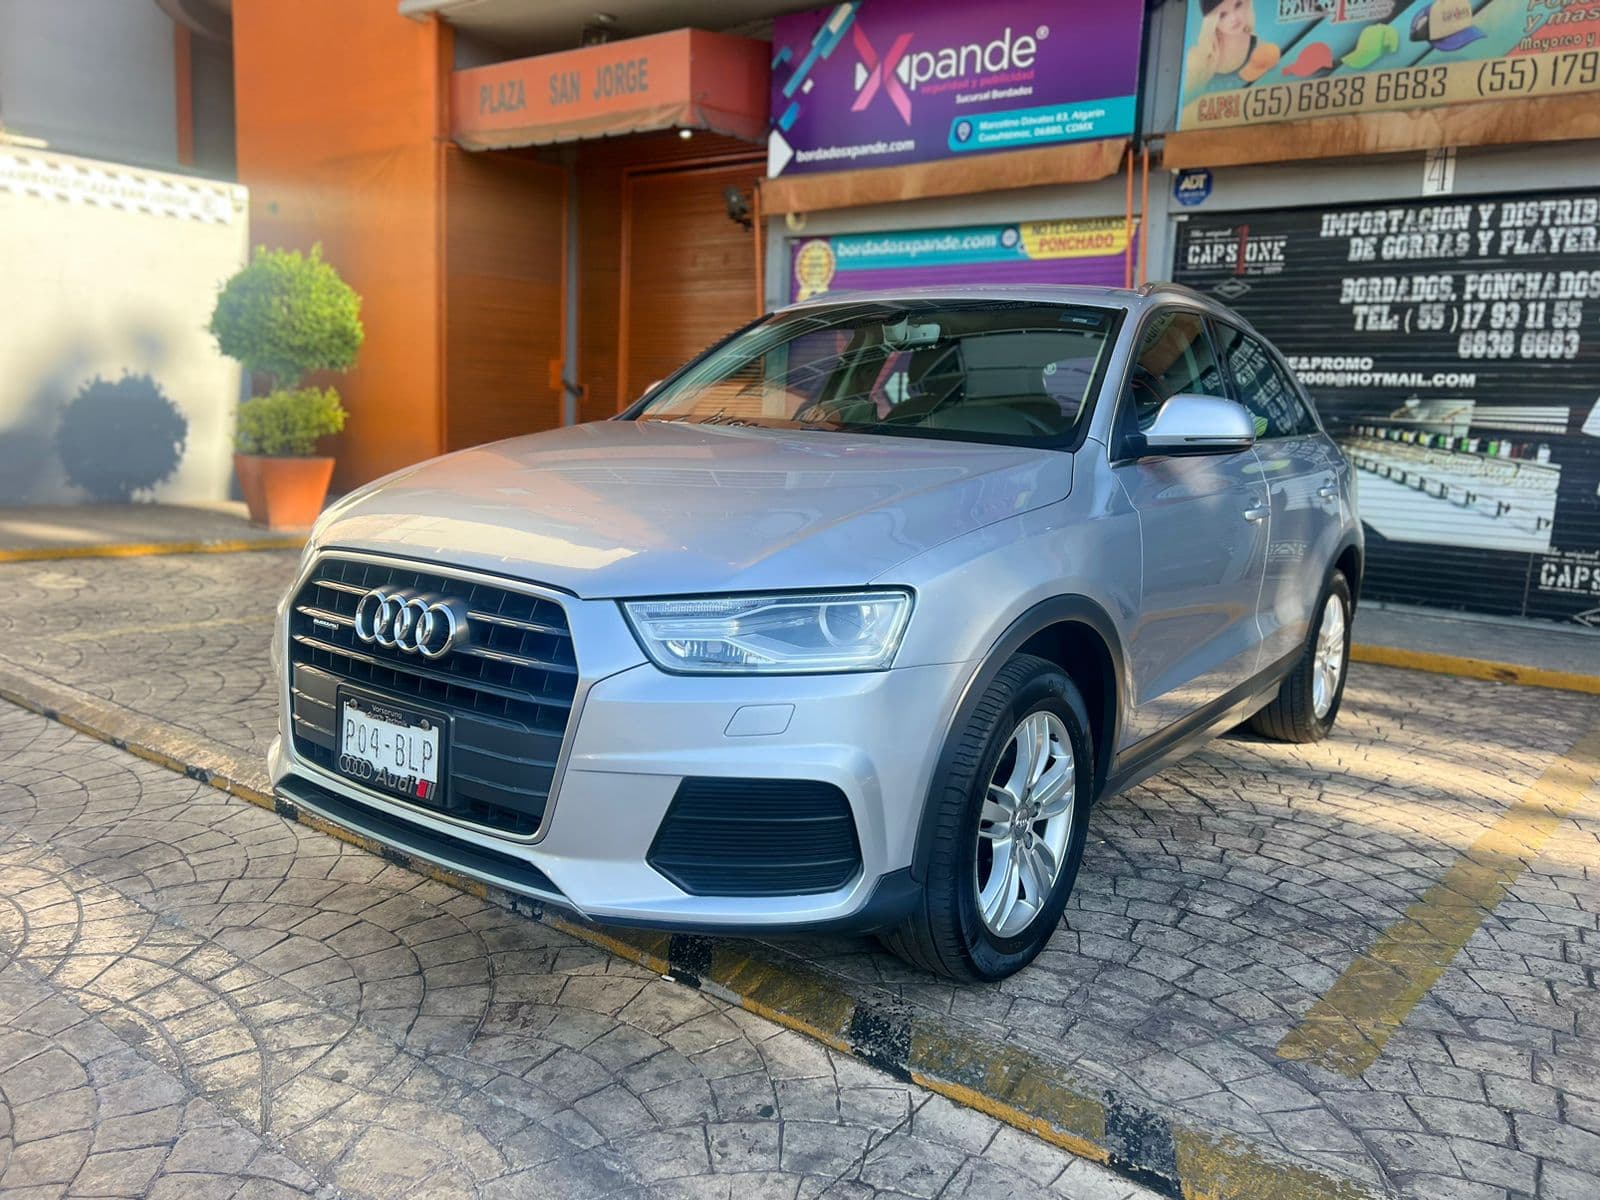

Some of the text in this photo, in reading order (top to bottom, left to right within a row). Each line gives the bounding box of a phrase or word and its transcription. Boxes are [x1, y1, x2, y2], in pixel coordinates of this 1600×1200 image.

[480, 58, 648, 116] PLAZA SAN JORGE
[991, 86, 1033, 100] Bordados
[1297, 74, 1365, 113] 6838
[1375, 67, 1447, 105] 6683
[1477, 57, 1538, 97] (55)
[796, 141, 915, 163] bordadosxpande.com
[1180, 174, 1208, 191] ADT
[1319, 198, 1600, 237] IMPORTACION Y DISTRIB
[837, 234, 997, 258] bordadosxpande.com
[1039, 233, 1114, 252] PONCHADO
[1347, 226, 1600, 262] DE GORRAS Y PLAYER
[1490, 301, 1521, 329] 93
[1525, 302, 1546, 329] 11
[1552, 301, 1583, 329] 55
[1284, 356, 1373, 370] E&PROMO
[375, 767, 416, 794] Audi
